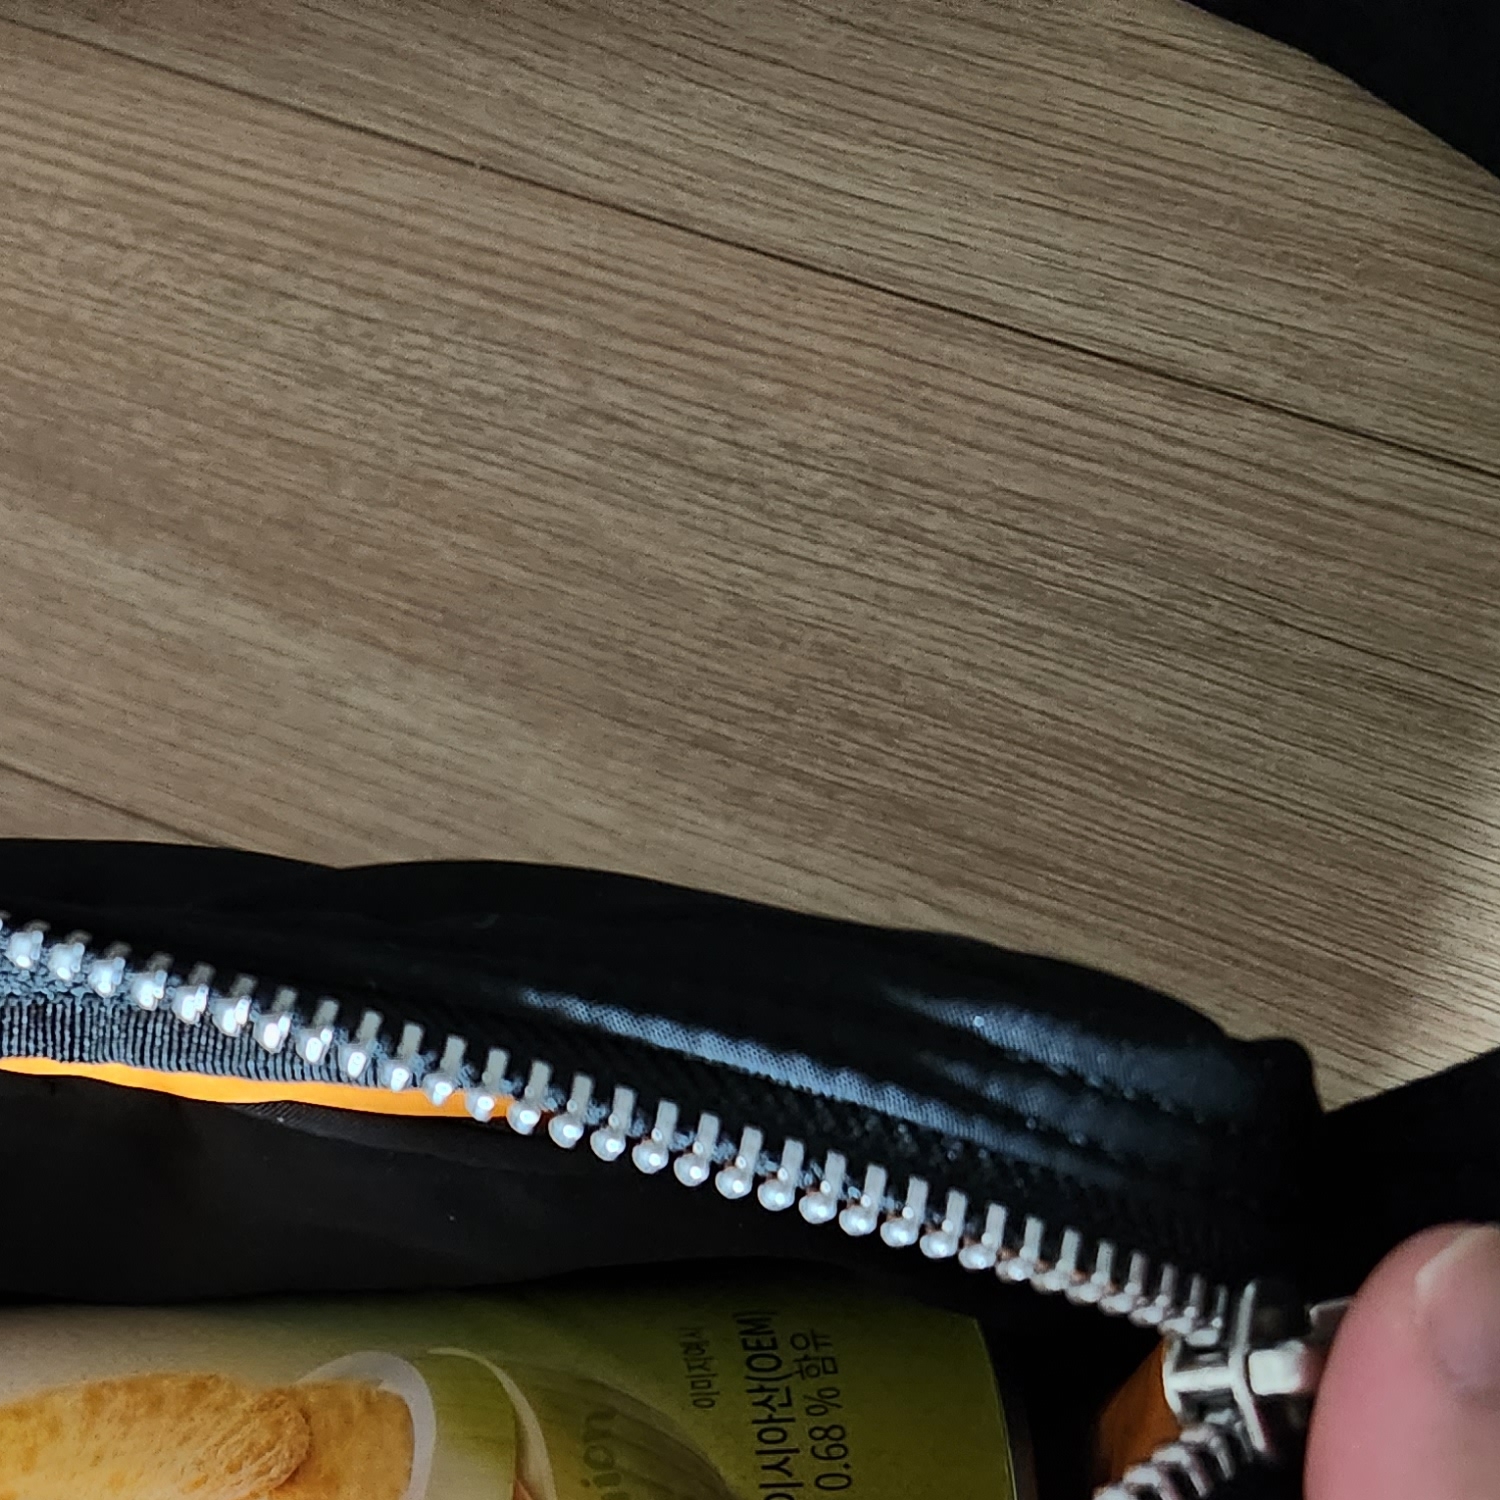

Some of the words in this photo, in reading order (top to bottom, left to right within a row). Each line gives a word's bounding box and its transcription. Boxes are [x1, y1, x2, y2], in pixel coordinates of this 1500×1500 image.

[679, 1325, 720, 1410] 이미지예시
[790, 1328, 839, 1380] 함유
[804, 1386, 844, 1417] %
[808, 1424, 854, 1491] 0.68
